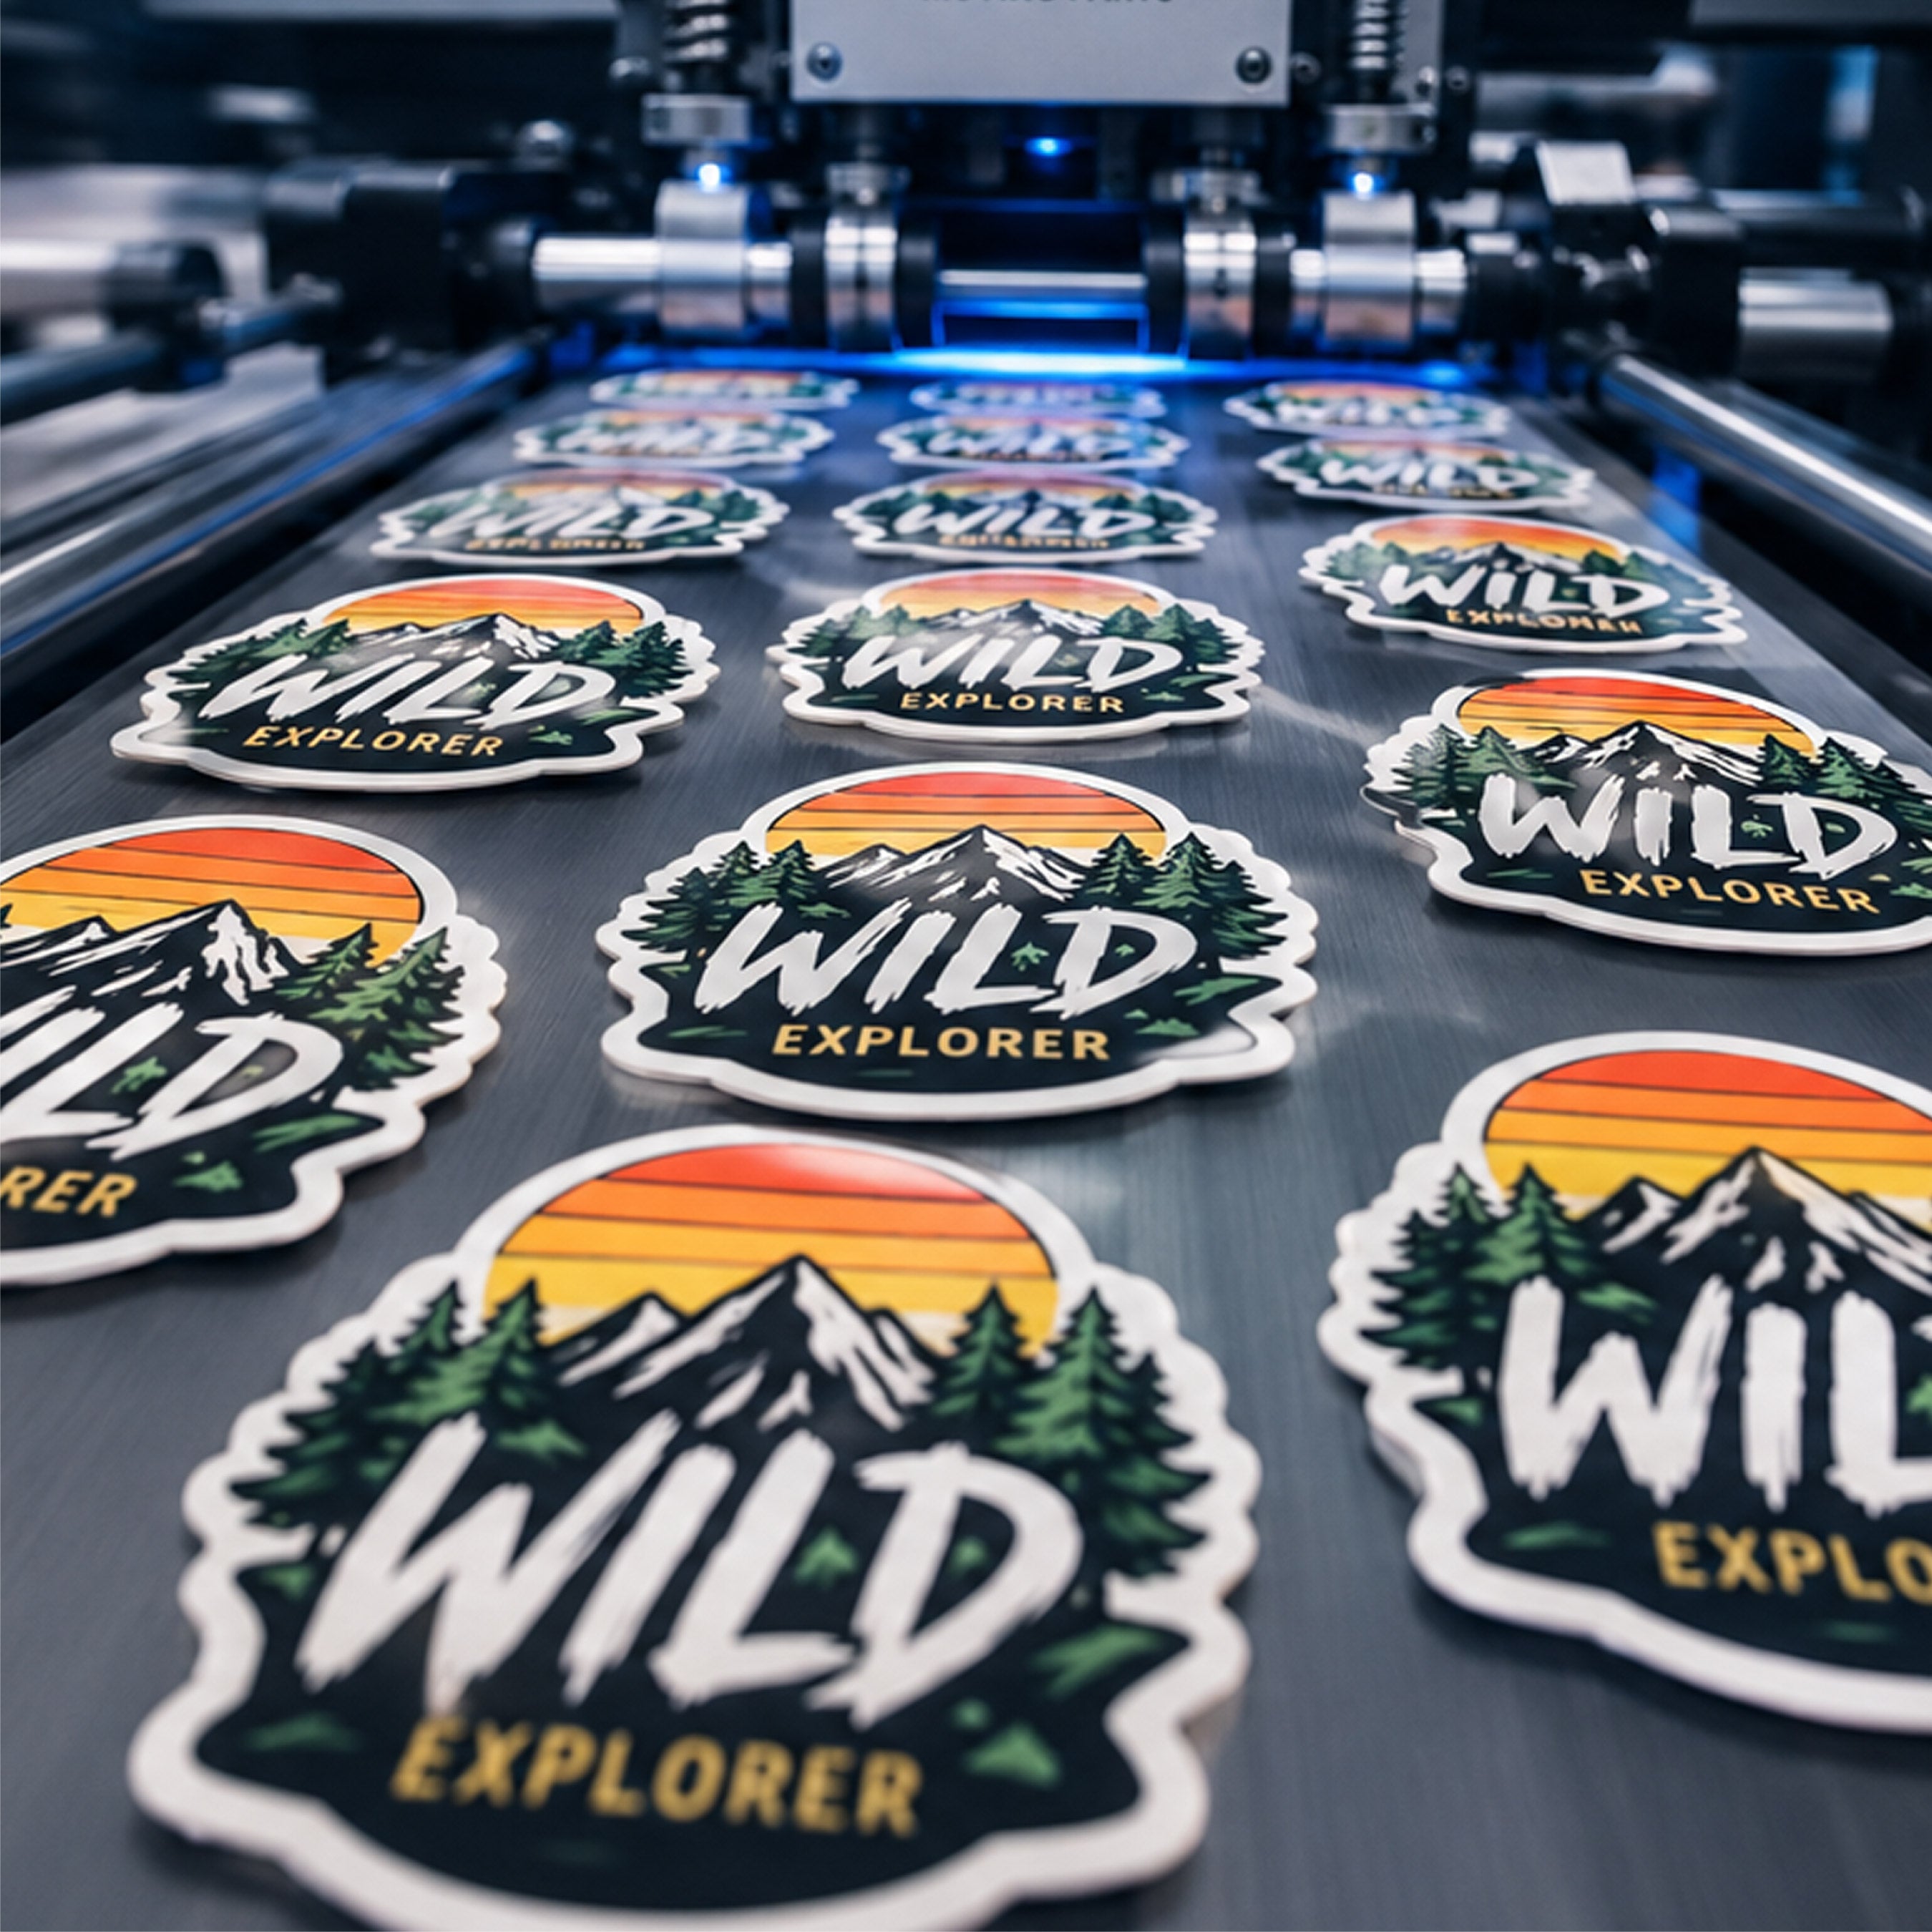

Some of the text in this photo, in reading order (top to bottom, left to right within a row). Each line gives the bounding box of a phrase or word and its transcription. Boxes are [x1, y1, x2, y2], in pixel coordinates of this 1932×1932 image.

[893, 504, 1156, 538] WILD
[1377, 562, 1671, 618] WILD
[197, 653, 627, 731] WILD
[841, 633, 1184, 693] WILD
[242, 724, 504, 757] EXPLORER
[899, 691, 1125, 714] EXPLORER
[1478, 772, 1898, 881] WILD
[1579, 868, 1880, 914] EXPLORER
[694, 897, 1198, 1020] WILD
[0, 984, 344, 1161] ILD
[771, 1023, 1110, 1060] EXPLORER
[1499, 1274, 1932, 1521] WIL
[294, 1413, 1083, 1729] WILD
[1652, 1518, 1932, 1605] EXPLO
[389, 1716, 926, 1836] EXPLORER
